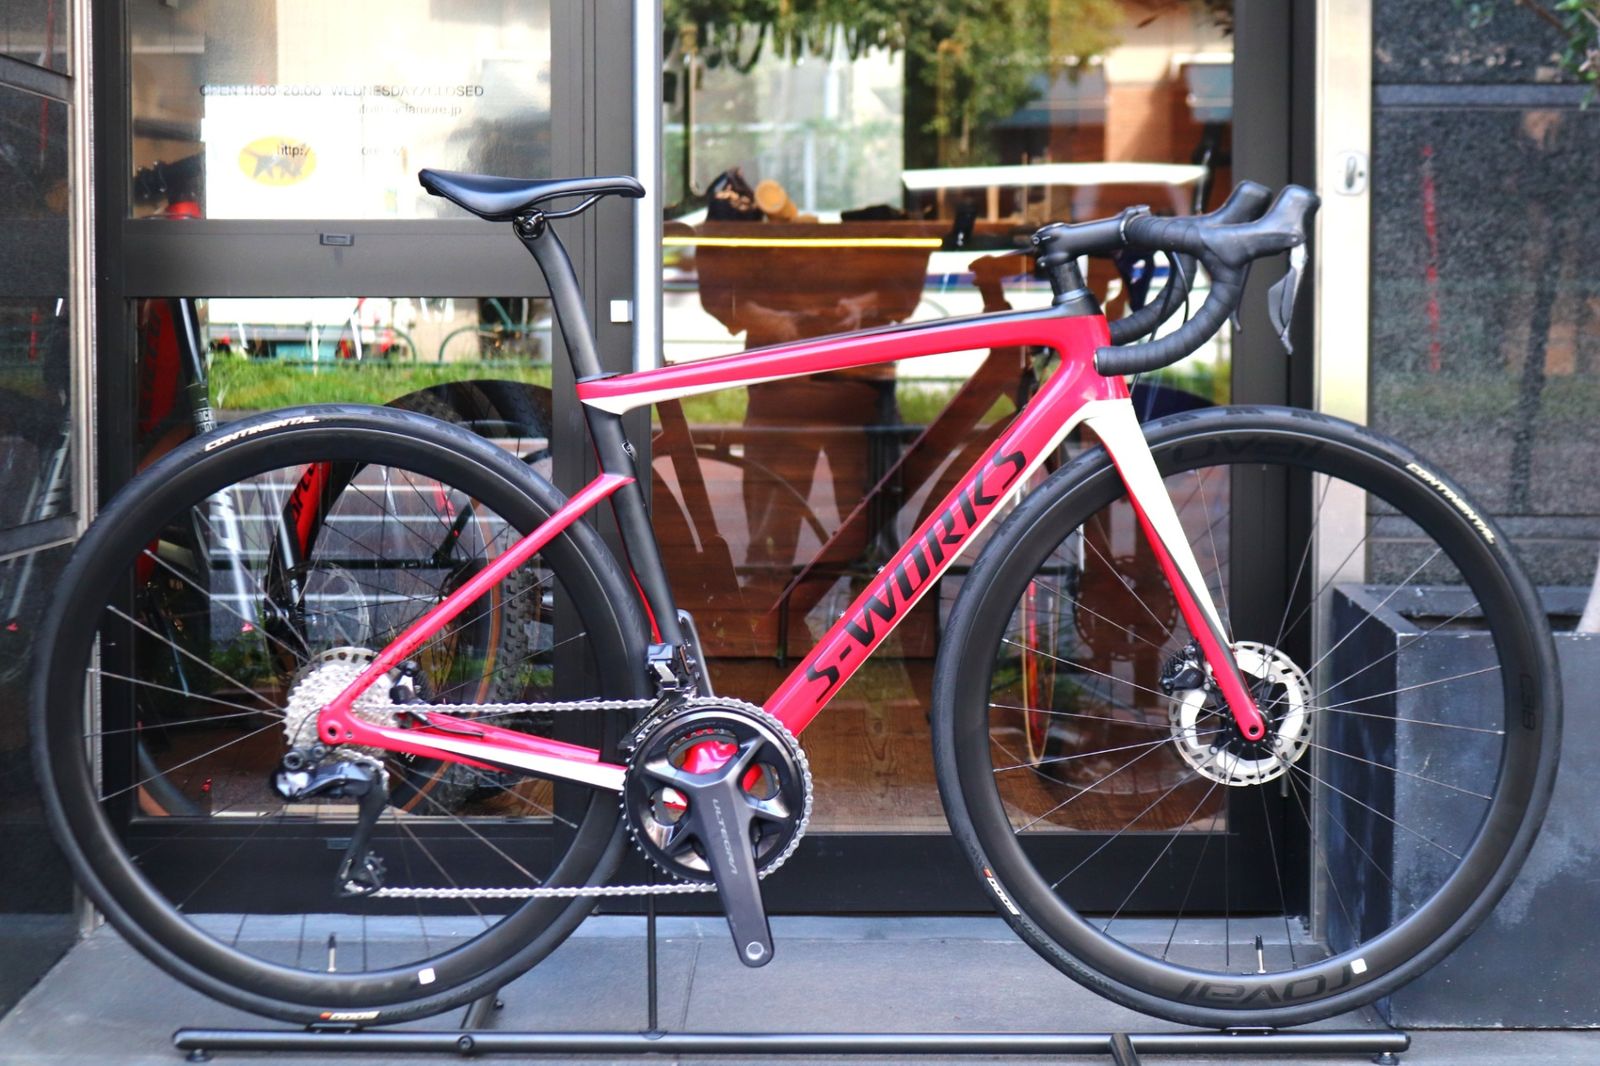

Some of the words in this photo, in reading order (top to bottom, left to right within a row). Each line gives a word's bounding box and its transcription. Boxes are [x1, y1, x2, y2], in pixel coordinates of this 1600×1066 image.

[204, 414, 321, 452] CONTINENTAL
[1406, 462, 1496, 545] CONTINENTAL
[806, 450, 1027, 704] S-WORKS
